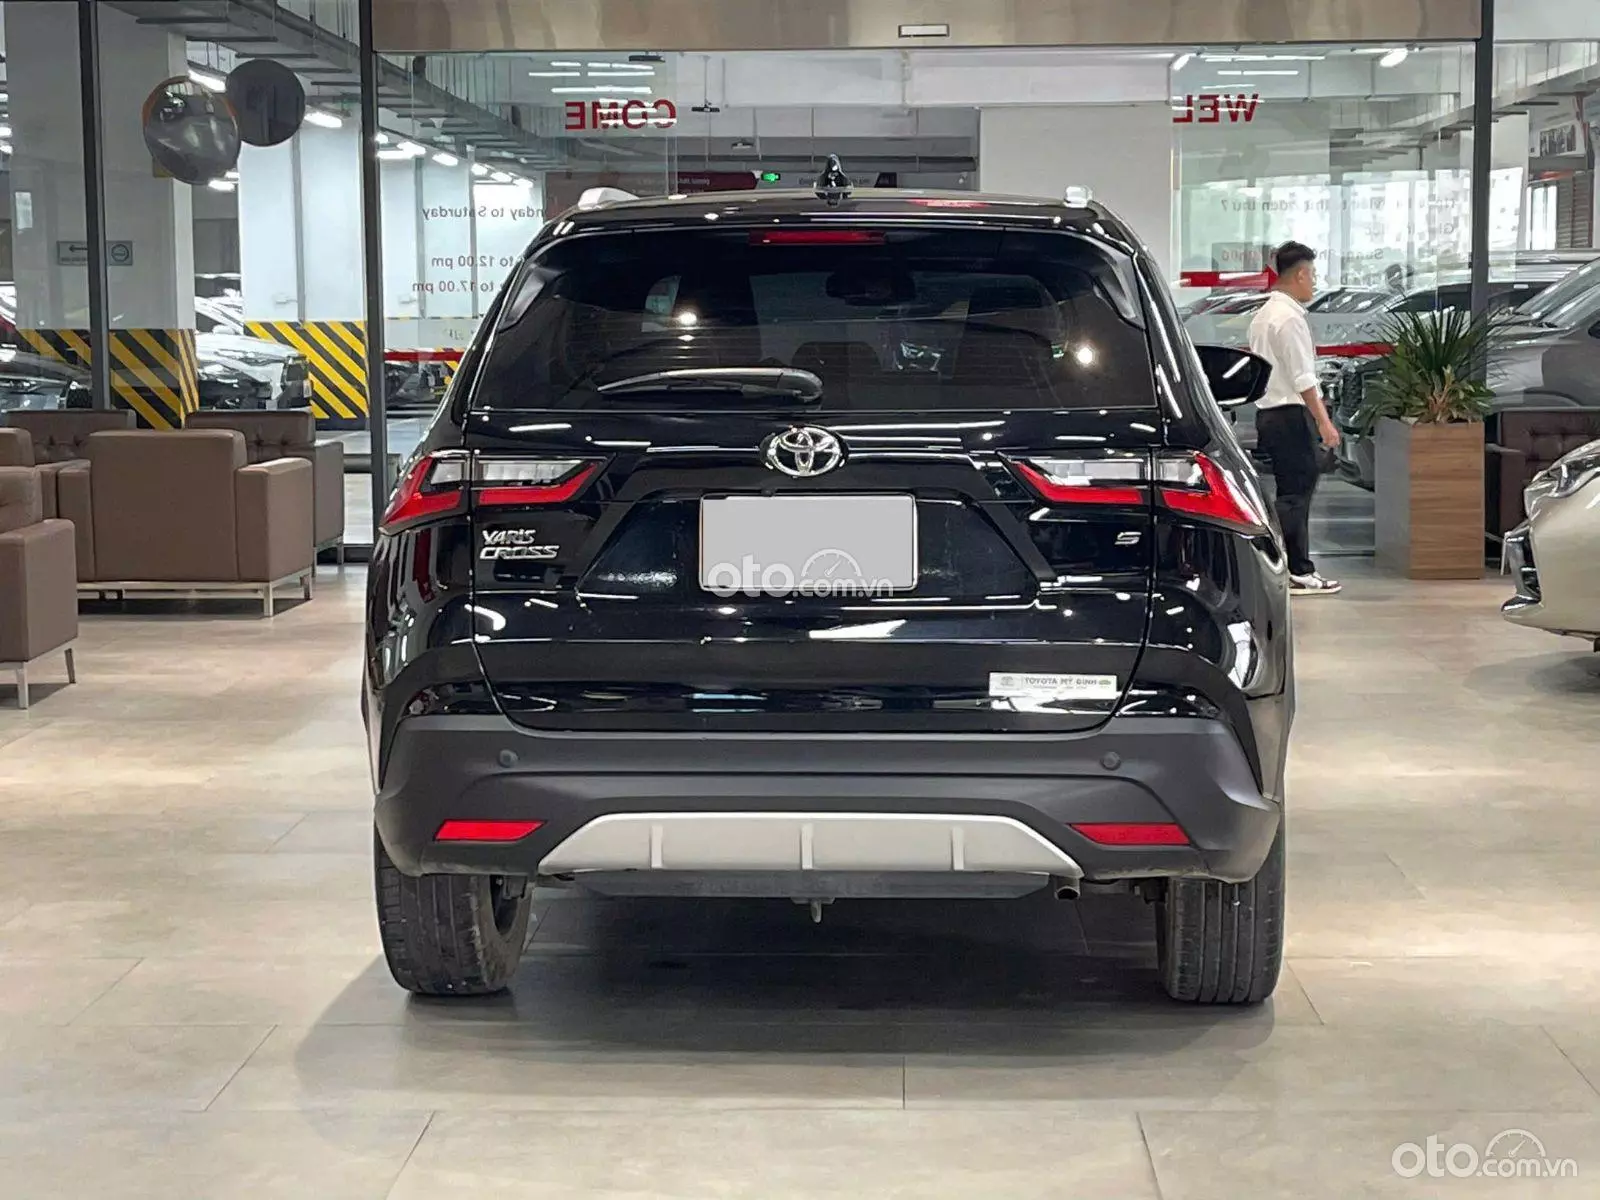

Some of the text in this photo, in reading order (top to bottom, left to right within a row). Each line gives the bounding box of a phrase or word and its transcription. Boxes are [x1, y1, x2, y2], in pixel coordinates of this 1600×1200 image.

[482, 529, 536, 545] YARIS
[1114, 531, 1142, 545] S
[480, 545, 560, 559] CROSS
[1024, 676, 1057, 685] TOYOTA
